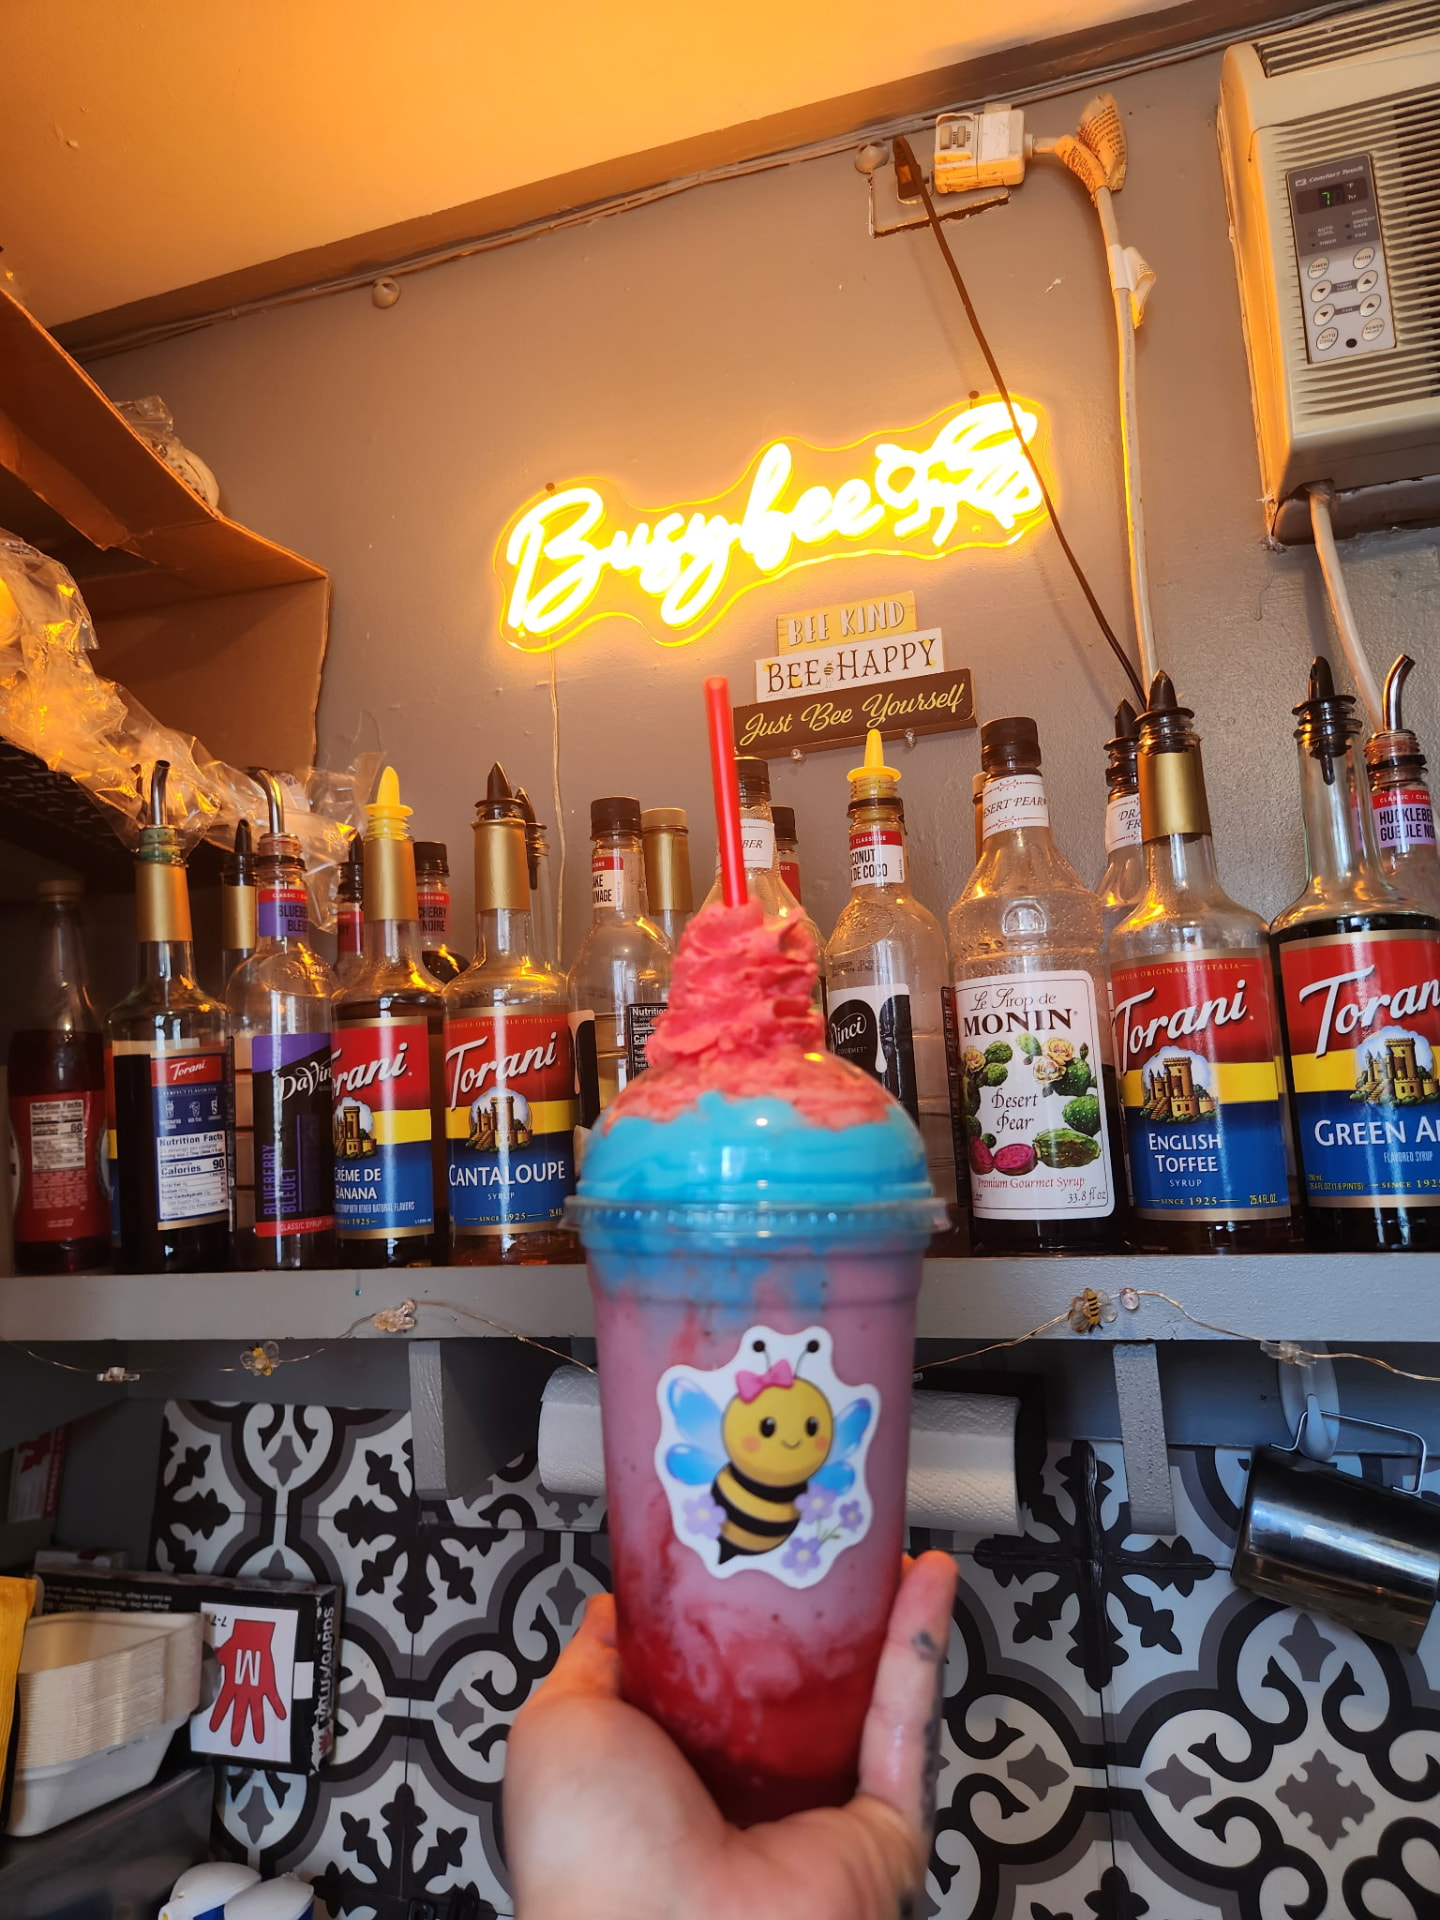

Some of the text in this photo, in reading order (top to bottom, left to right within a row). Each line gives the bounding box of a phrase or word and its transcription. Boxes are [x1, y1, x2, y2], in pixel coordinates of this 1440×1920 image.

[787, 599, 905, 647] BEE KIND
[767, 637, 936, 694] BEE HAPPY
[739, 682, 965, 746] Just Bee Yourself
[1013, 796, 1043, 807] PEAR
[742, 839, 763, 849] BER
[863, 863, 888, 879] COCO
[969, 987, 1057, 1012] Le Sirop de
[1298, 963, 1440, 1059] Toran
[963, 1008, 1073, 1037] MONIN
[1113, 979, 1248, 1077] Torani
[169, 1059, 206, 1081] Torani
[445, 1031, 557, 1112] Torani
[991, 1087, 1039, 1108] Desert
[995, 1109, 1034, 1134] Pear
[1314, 1115, 1440, 1147] GREEN A
[159, 1133, 224, 1147] Nutrition Facts
[1148, 1132, 1222, 1151] ENGLISH
[161, 1165, 202, 1176] Calories
[212, 1158, 225, 1170] 90
[448, 1160, 566, 1187] CANTALOUPE
[1154, 1154, 1218, 1173] TOFFEE
[364, 1167, 382, 1182] DE
[1009, 1177, 1054, 1189] Gourmet
[1057, 1177, 1085, 1192] Syrup
[1169, 1179, 1202, 1188] SYRUP
[335, 1184, 378, 1200] BANANA
[1067, 1191, 1087, 1204] 33.8
[1097, 1190, 1107, 1200] oz
[1188, 1196, 1218, 1206] 1925
[503, 1212, 527, 1222] 1925
[234, 1649, 262, 1687] M
